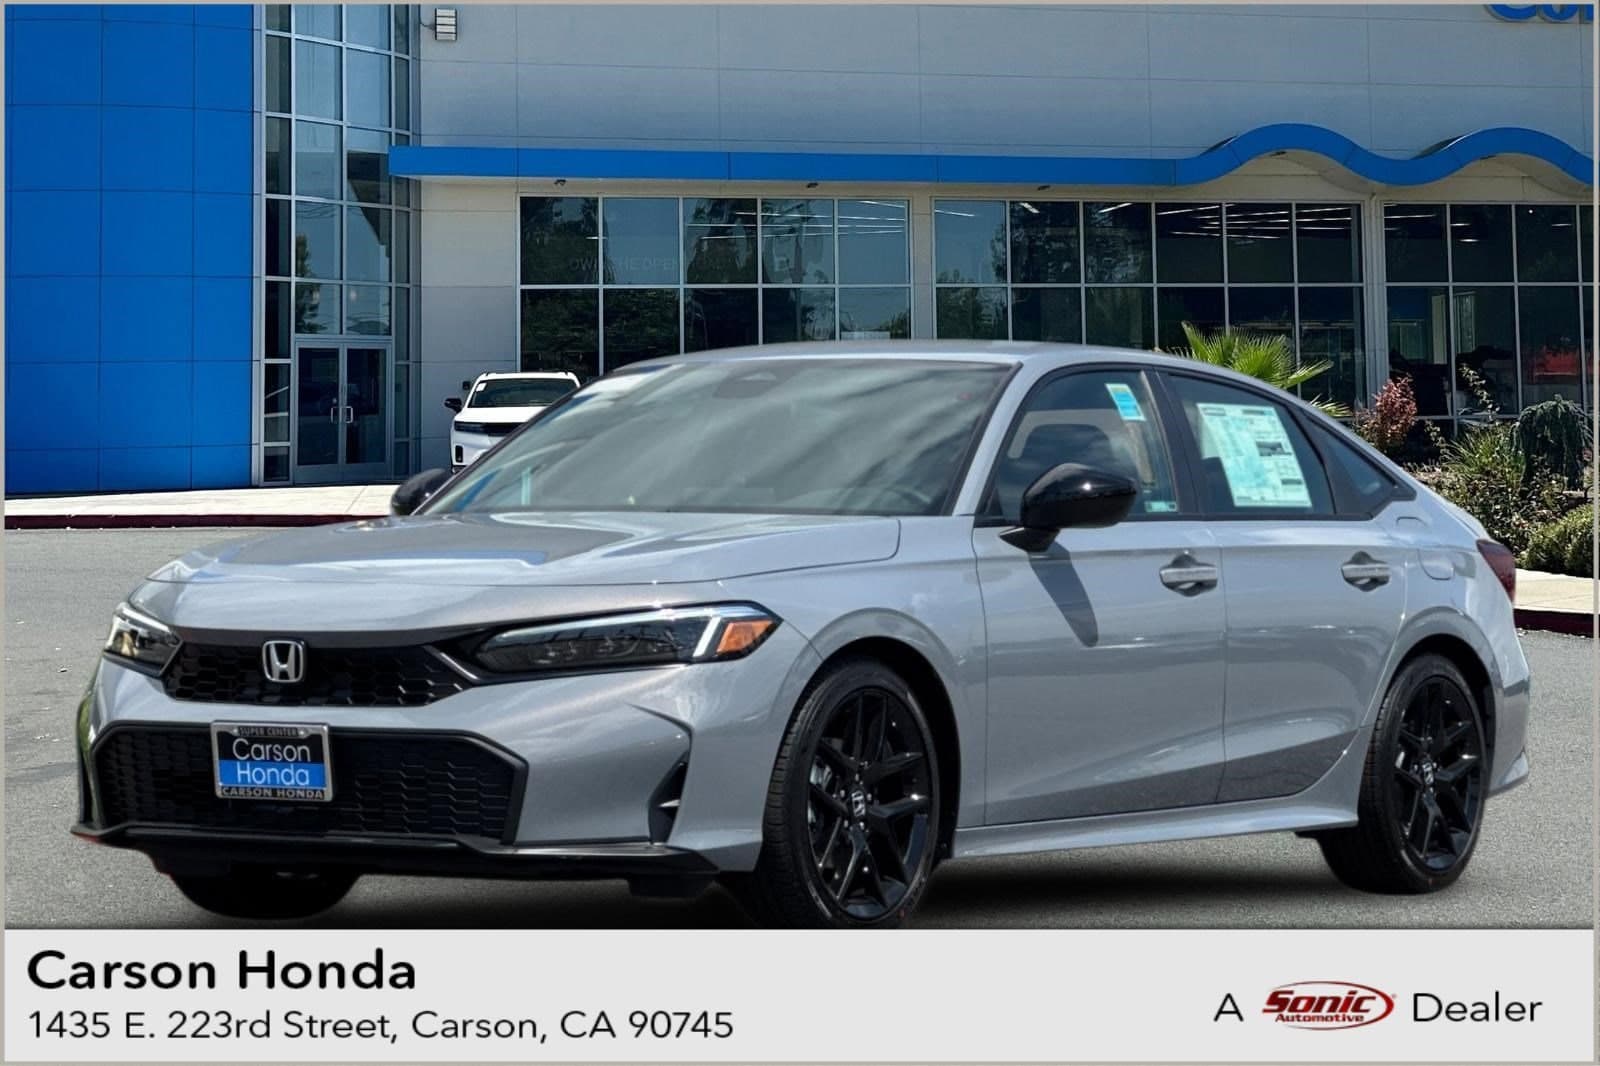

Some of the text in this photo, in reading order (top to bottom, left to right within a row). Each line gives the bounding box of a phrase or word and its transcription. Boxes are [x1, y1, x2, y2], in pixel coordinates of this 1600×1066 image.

[267, 728, 297, 736] CENTER
[232, 738, 311, 762] Carson
[237, 762, 310, 786] Honda
[222, 786, 324, 800] CARSON HONDA
